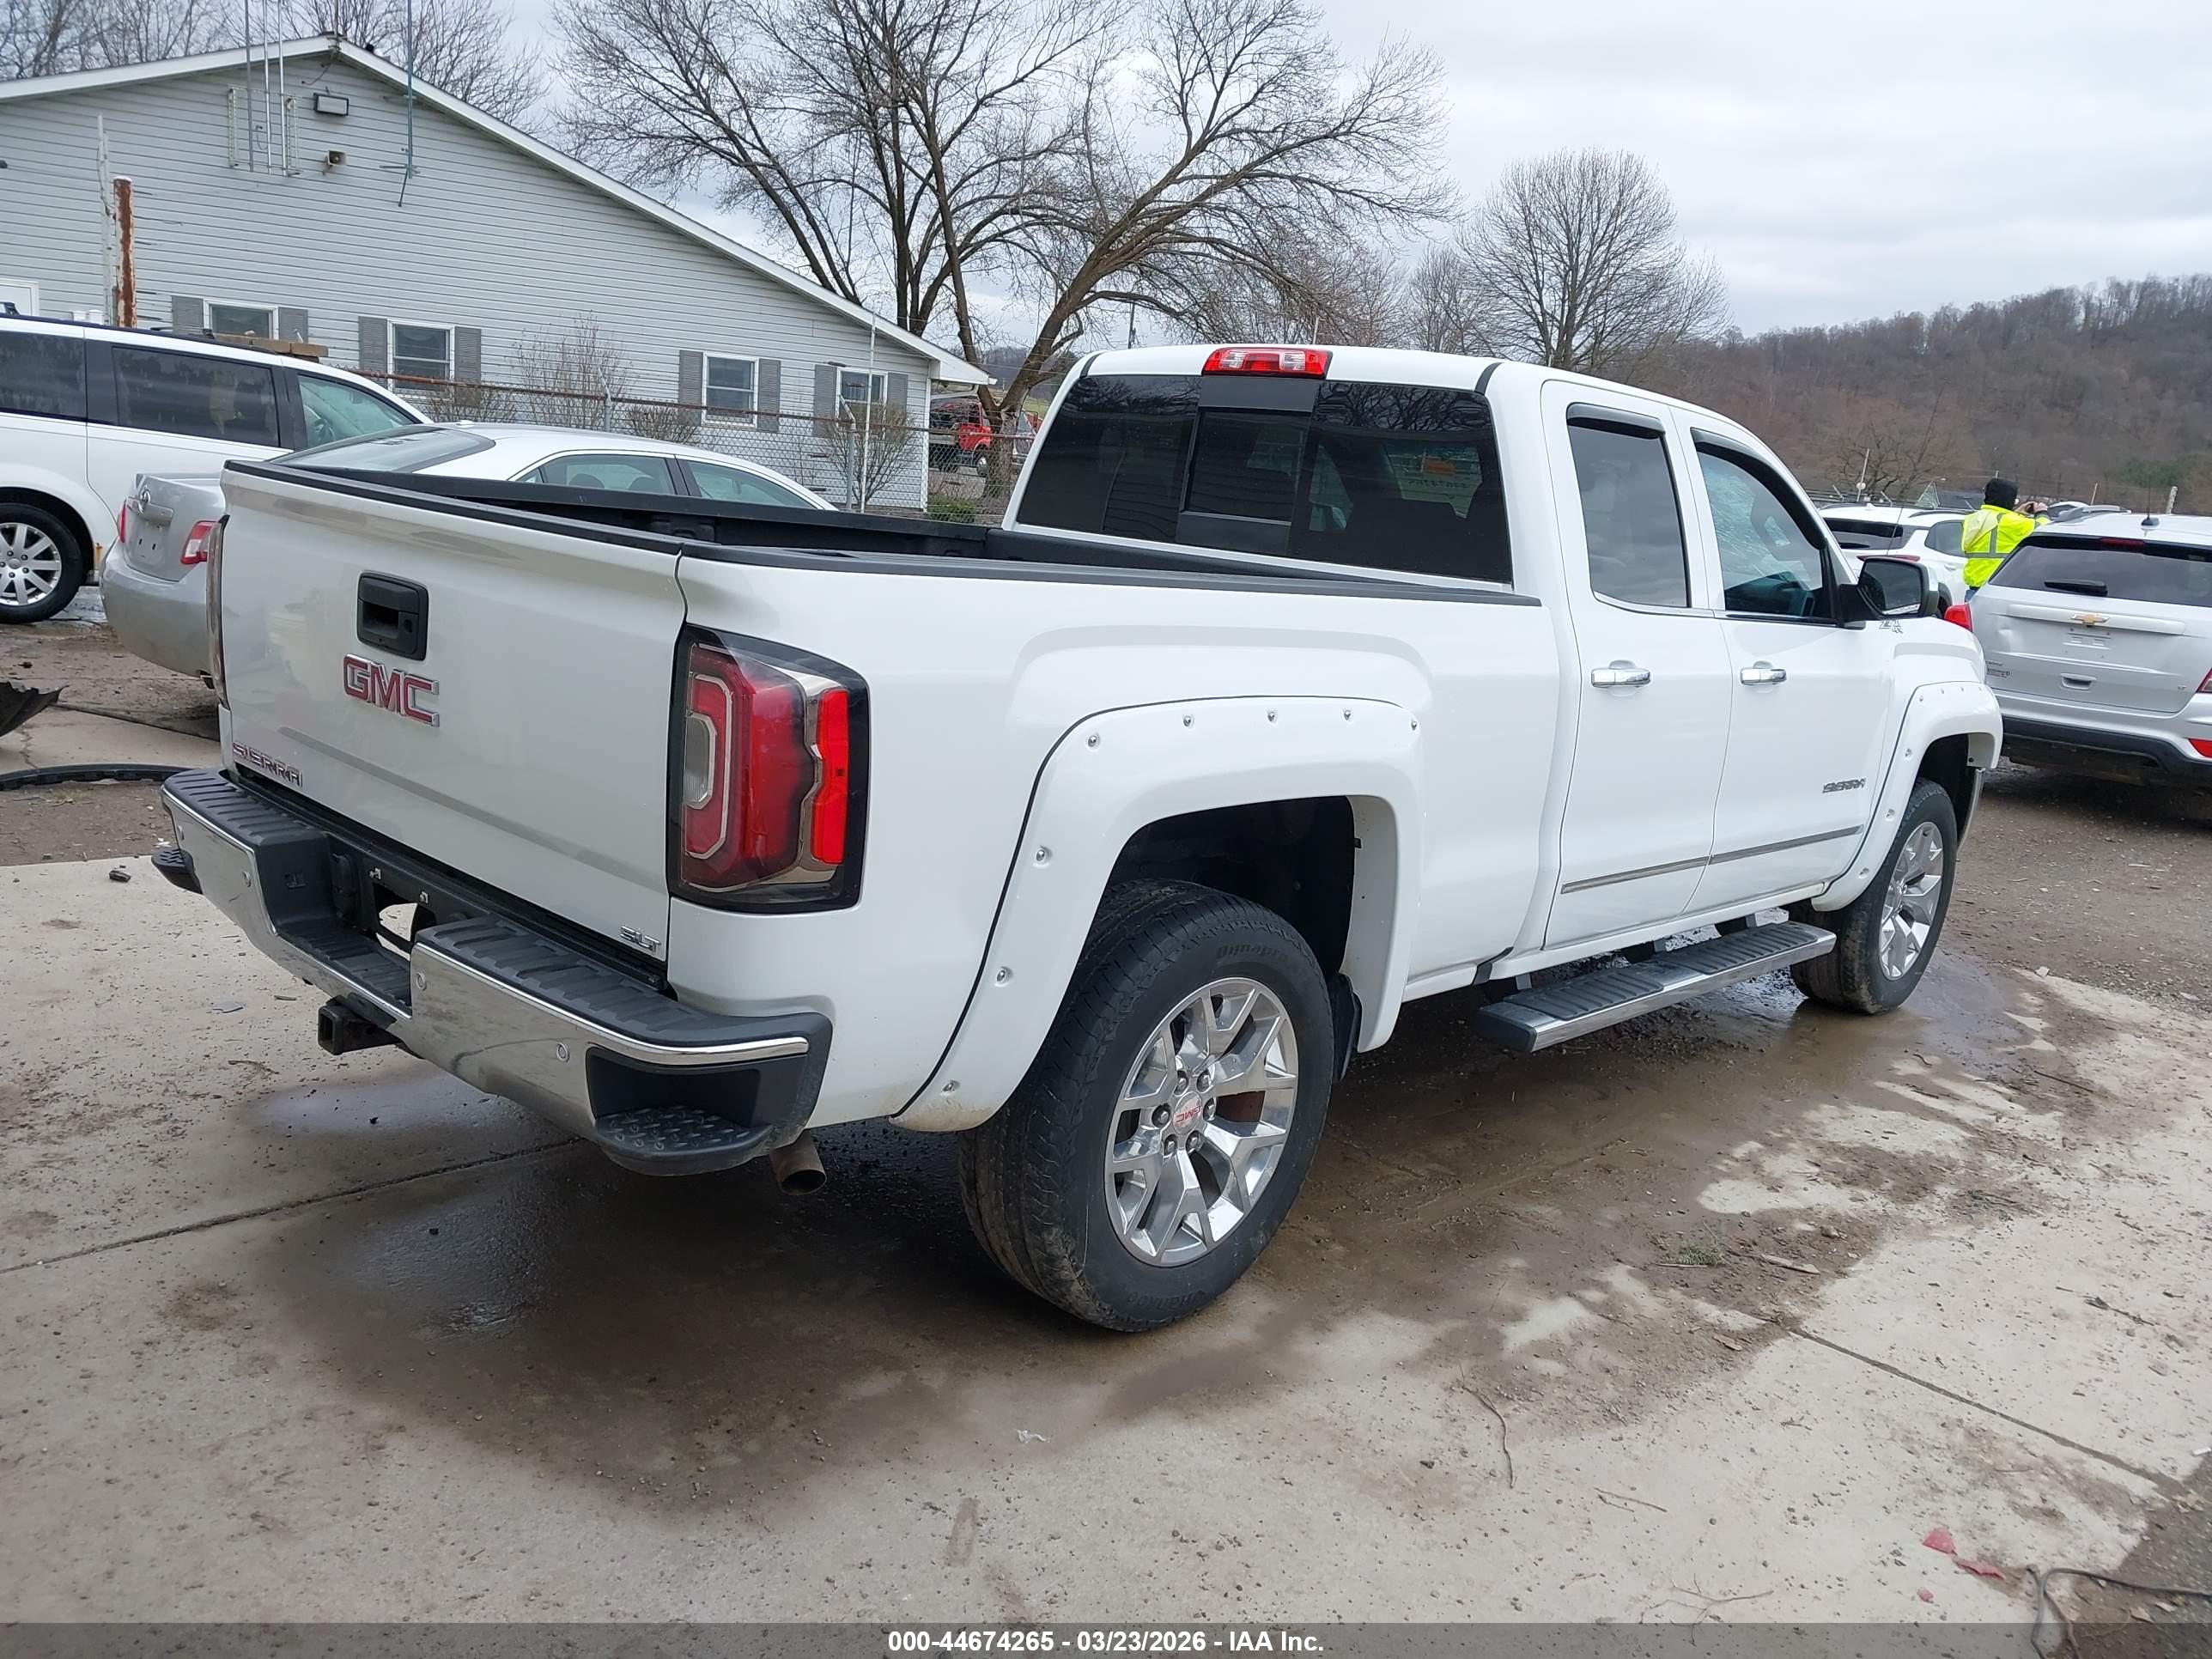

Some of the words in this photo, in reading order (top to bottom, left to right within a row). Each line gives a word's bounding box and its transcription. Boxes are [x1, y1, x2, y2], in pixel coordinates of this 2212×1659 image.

[343, 653, 440, 727] GMC
[233, 741, 303, 787] SIERRA
[620, 926, 661, 953] SLT
[1176, 1105, 1201, 1123] GMC
